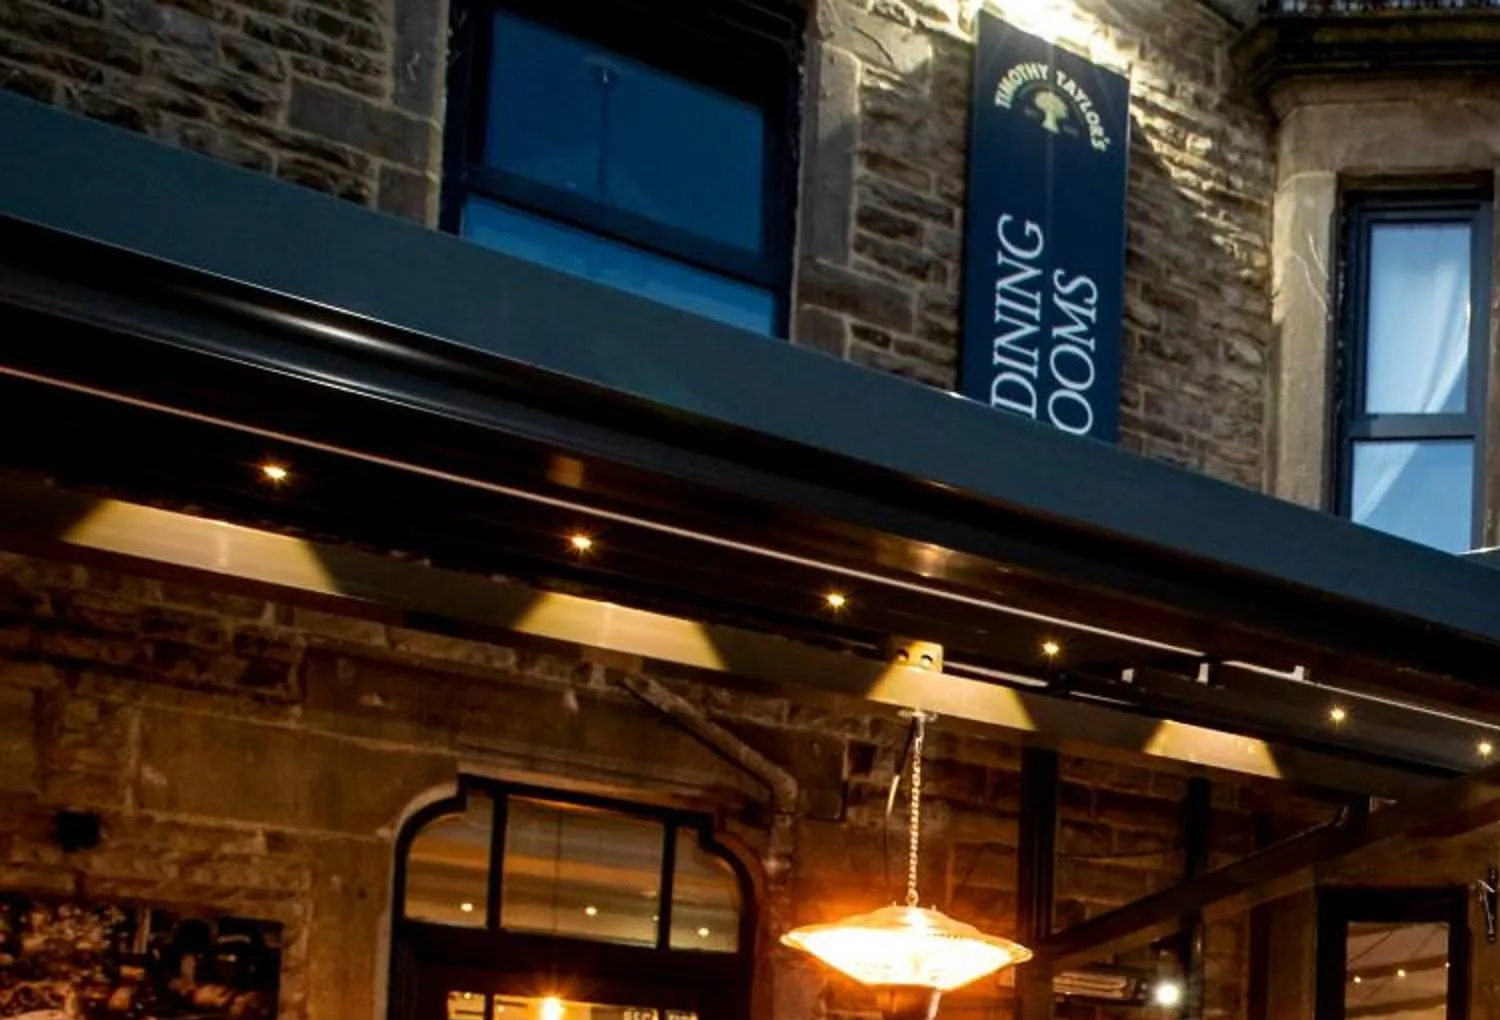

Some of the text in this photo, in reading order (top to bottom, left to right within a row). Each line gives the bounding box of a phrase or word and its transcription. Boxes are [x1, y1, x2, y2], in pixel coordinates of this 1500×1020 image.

[995, 62, 1048, 110] TIMOTHY
[1055, 70, 1111, 152] TAYLOR'S
[990, 213, 1045, 419] DINING
[1047, 269, 1098, 436] OOMS
